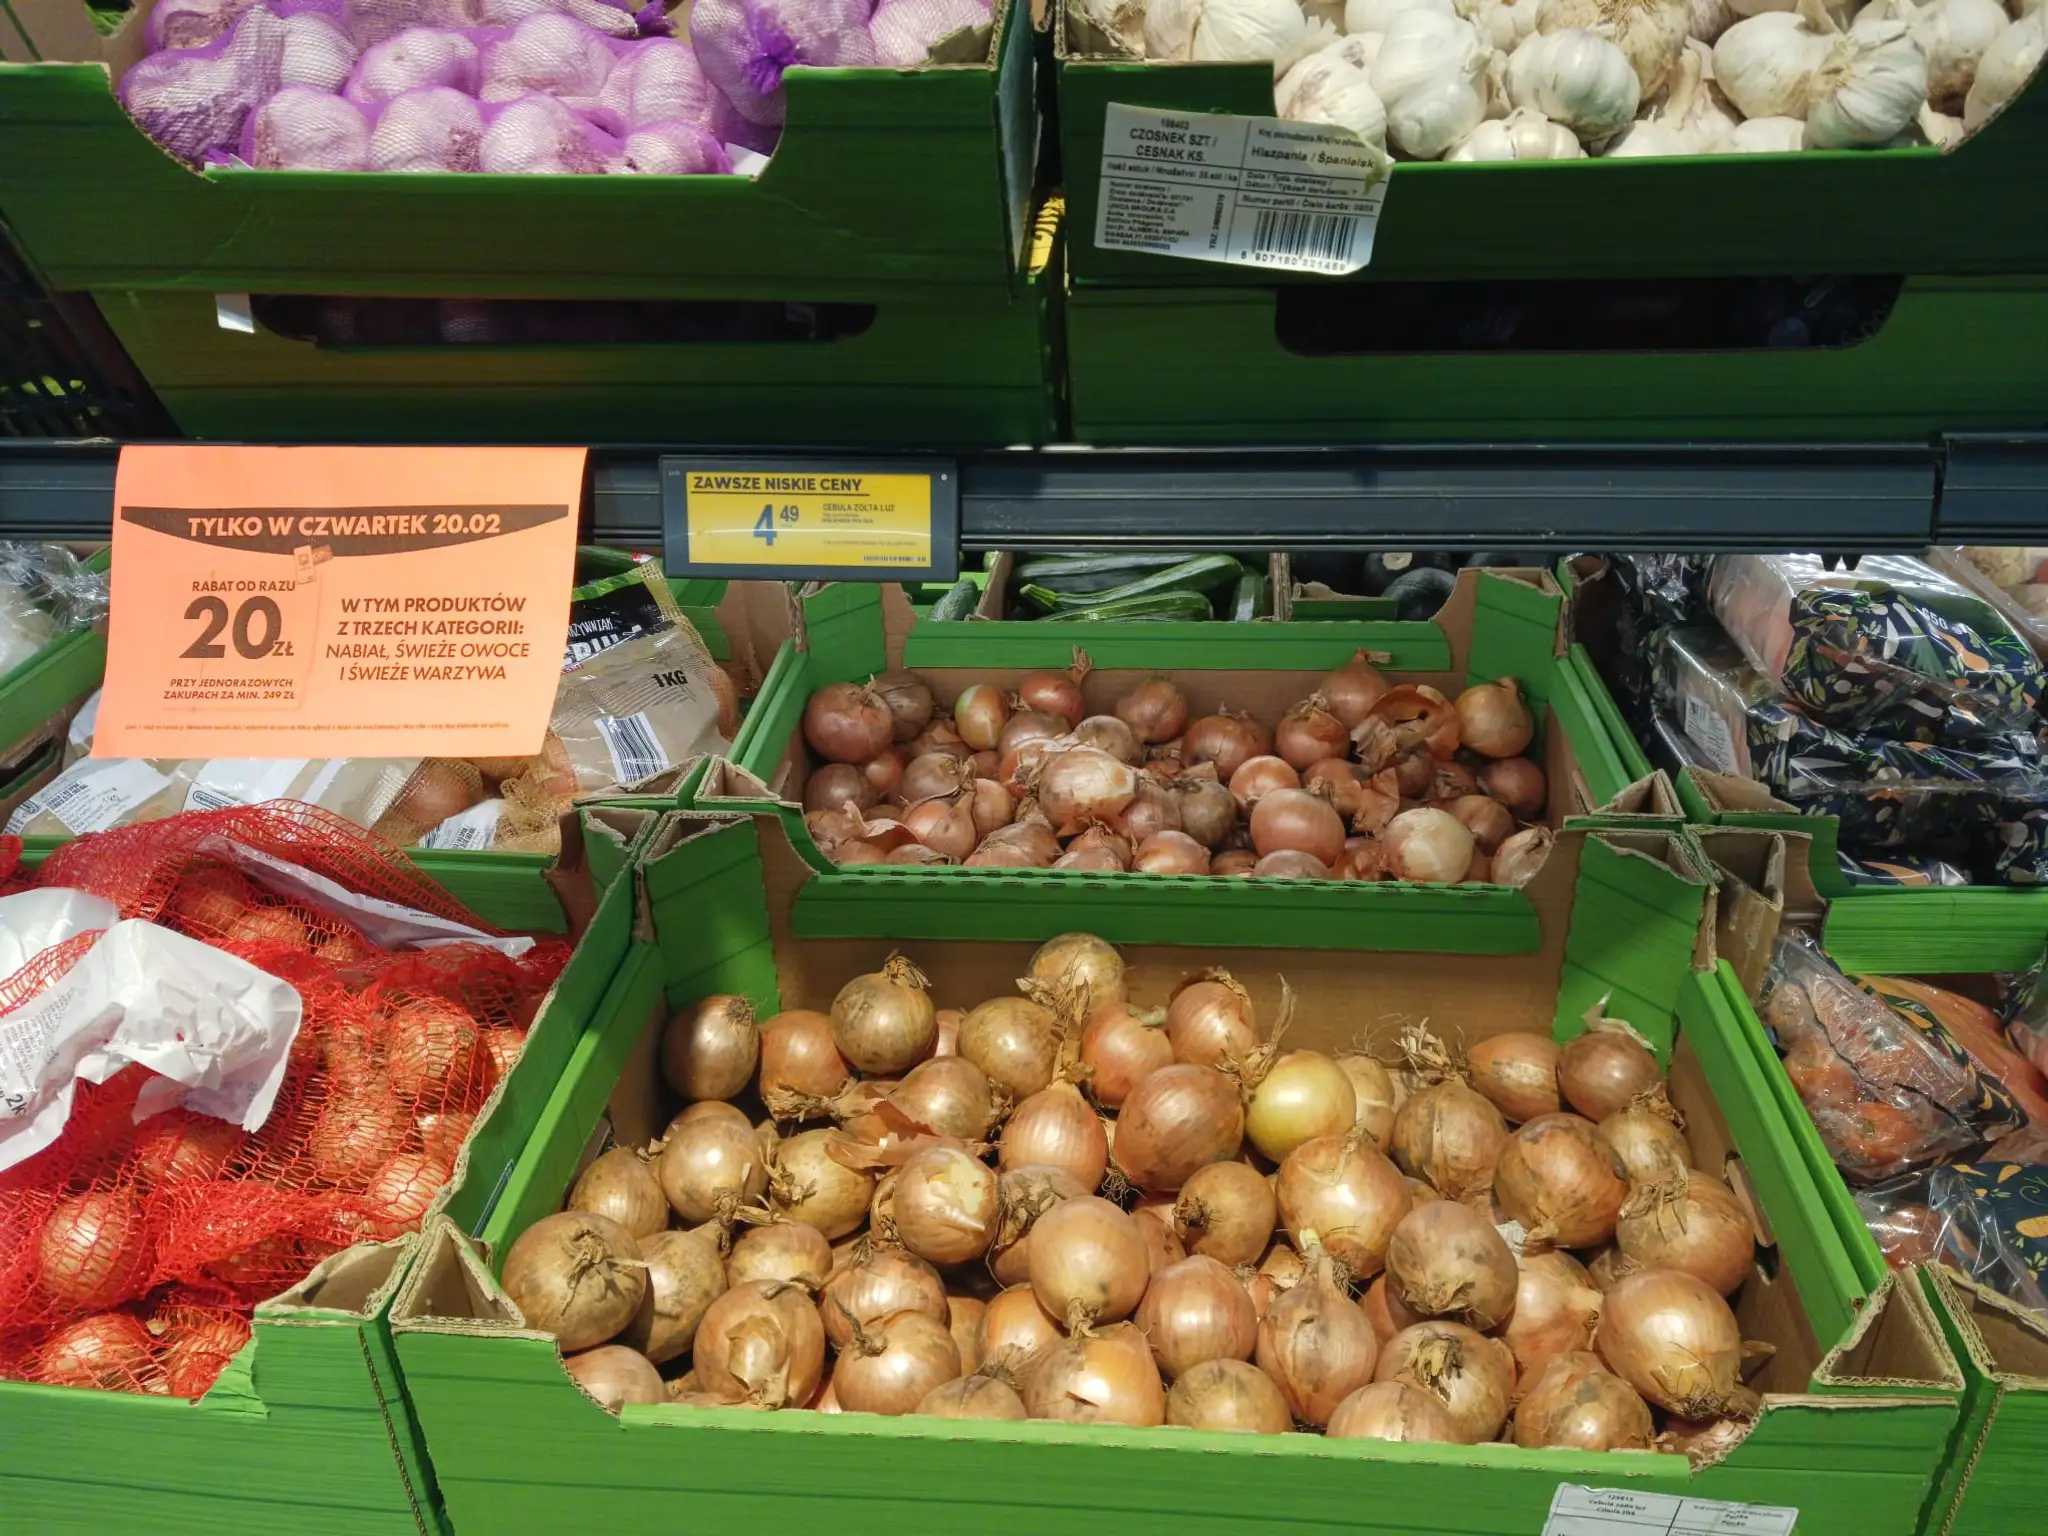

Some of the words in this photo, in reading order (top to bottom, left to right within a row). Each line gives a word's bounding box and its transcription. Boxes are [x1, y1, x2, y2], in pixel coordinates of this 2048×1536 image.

[1129, 127, 1186, 144] CZOSNEK
[1188, 133, 1212, 147] SZT
[1135, 144, 1184, 160] CESNAK
[1187, 150, 1207, 162] KS.
[1251, 145, 1308, 162] Hiszpania
[1317, 150, 1374, 169] Španielsk
[693, 476, 761, 490] ZAWSZE
[765, 477, 816, 491] NISKIE
[820, 478, 863, 492] CENY
[187, 516, 264, 537] TYLKO
[267, 516, 295, 536] W
[298, 514, 428, 536] CZWARTEK
[432, 513, 500, 535] 20.02
[752, 504, 778, 547] 4
[780, 505, 799, 522] 49
[191, 580, 234, 592] RABAT
[235, 580, 256, 592] OD
[258, 580, 296, 592] RAZU
[340, 598, 361, 613] W
[363, 598, 400, 613] TYM
[403, 592, 527, 613] PRODUKTÓW
[178, 595, 282, 660] 20
[271, 640, 295, 657] ZŁ
[336, 621, 348, 636] Z
[352, 621, 418, 636] TRZECH
[420, 620, 525, 635] KATEGORII:
[567, 616, 614, 638] RZYWNIAK
[325, 643, 390, 660] NABIAŁ,
[395, 639, 457, 659] ŚWIEŻE
[459, 643, 531, 658] OWOCE
[339, 666, 345, 681] I
[347, 662, 410, 681] ŚWIEŻE
[412, 666, 507, 681] WARZYWA
[651, 673, 665, 688] 1
[661, 670, 689, 687] KG
[169, 678, 198, 688] PRZY
[198, 678, 294, 688] JEDNORAZOWYCH
[163, 690, 219, 700] ZAKUPACH
[220, 690, 234, 700] ZA
[235, 690, 261, 700] MIN.
[262, 690, 282, 700] 249
[282, 690, 296, 700] ZŁ
